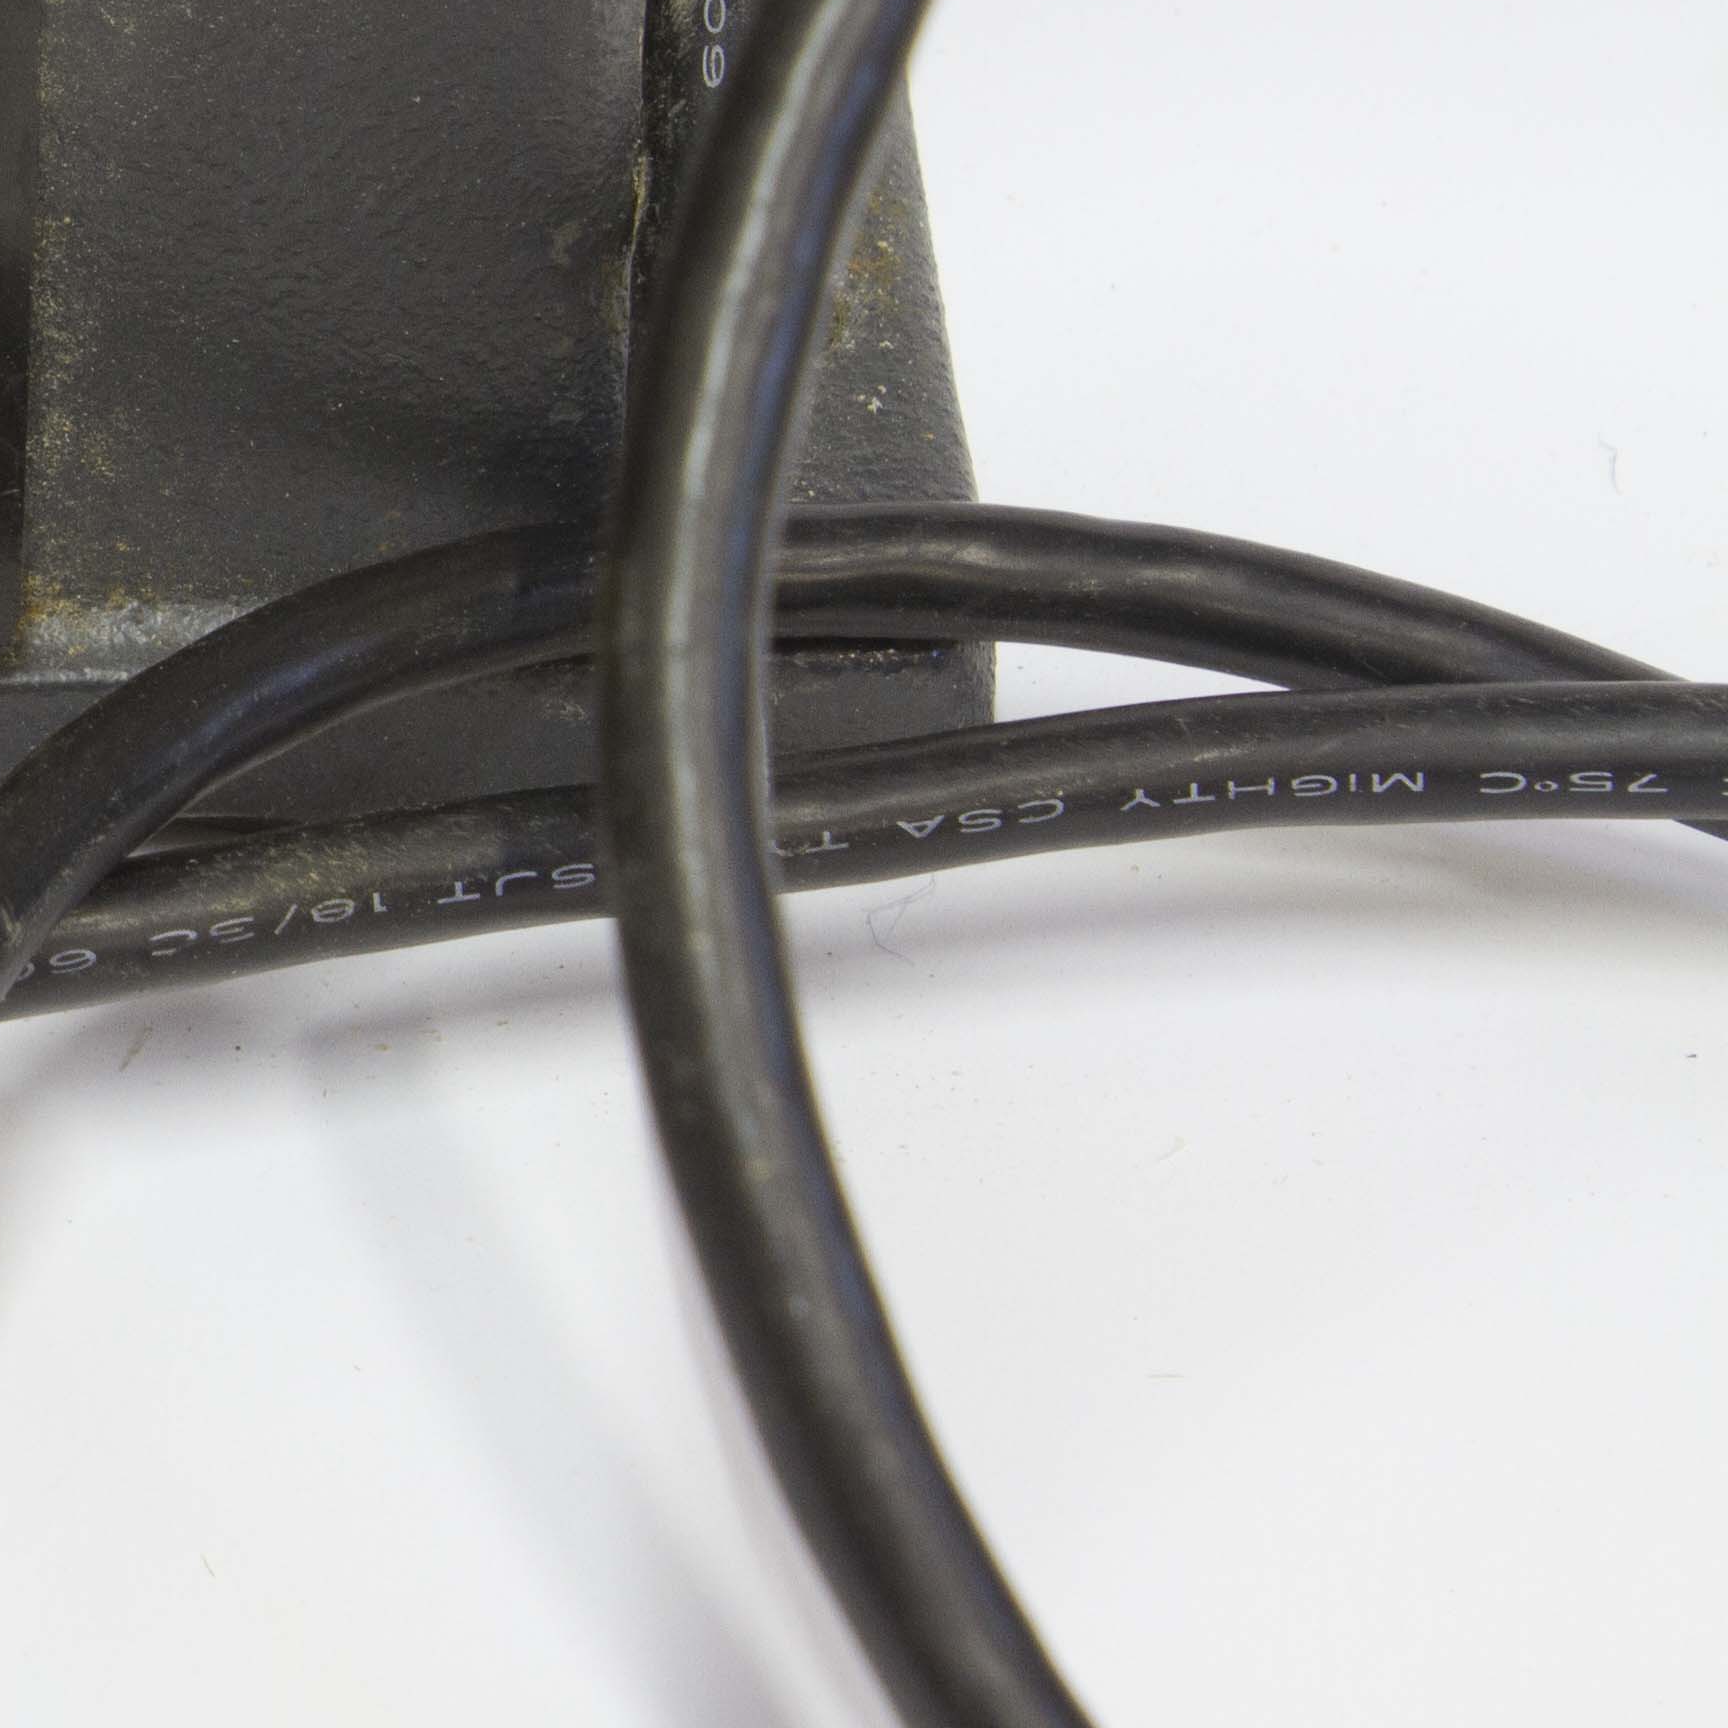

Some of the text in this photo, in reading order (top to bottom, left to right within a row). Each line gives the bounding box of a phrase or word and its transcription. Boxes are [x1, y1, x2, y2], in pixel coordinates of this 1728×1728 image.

[1120, 771, 1425, 812] MIGHTY
[897, 798, 1066, 840] CSA
[437, 863, 596, 904] SJT
